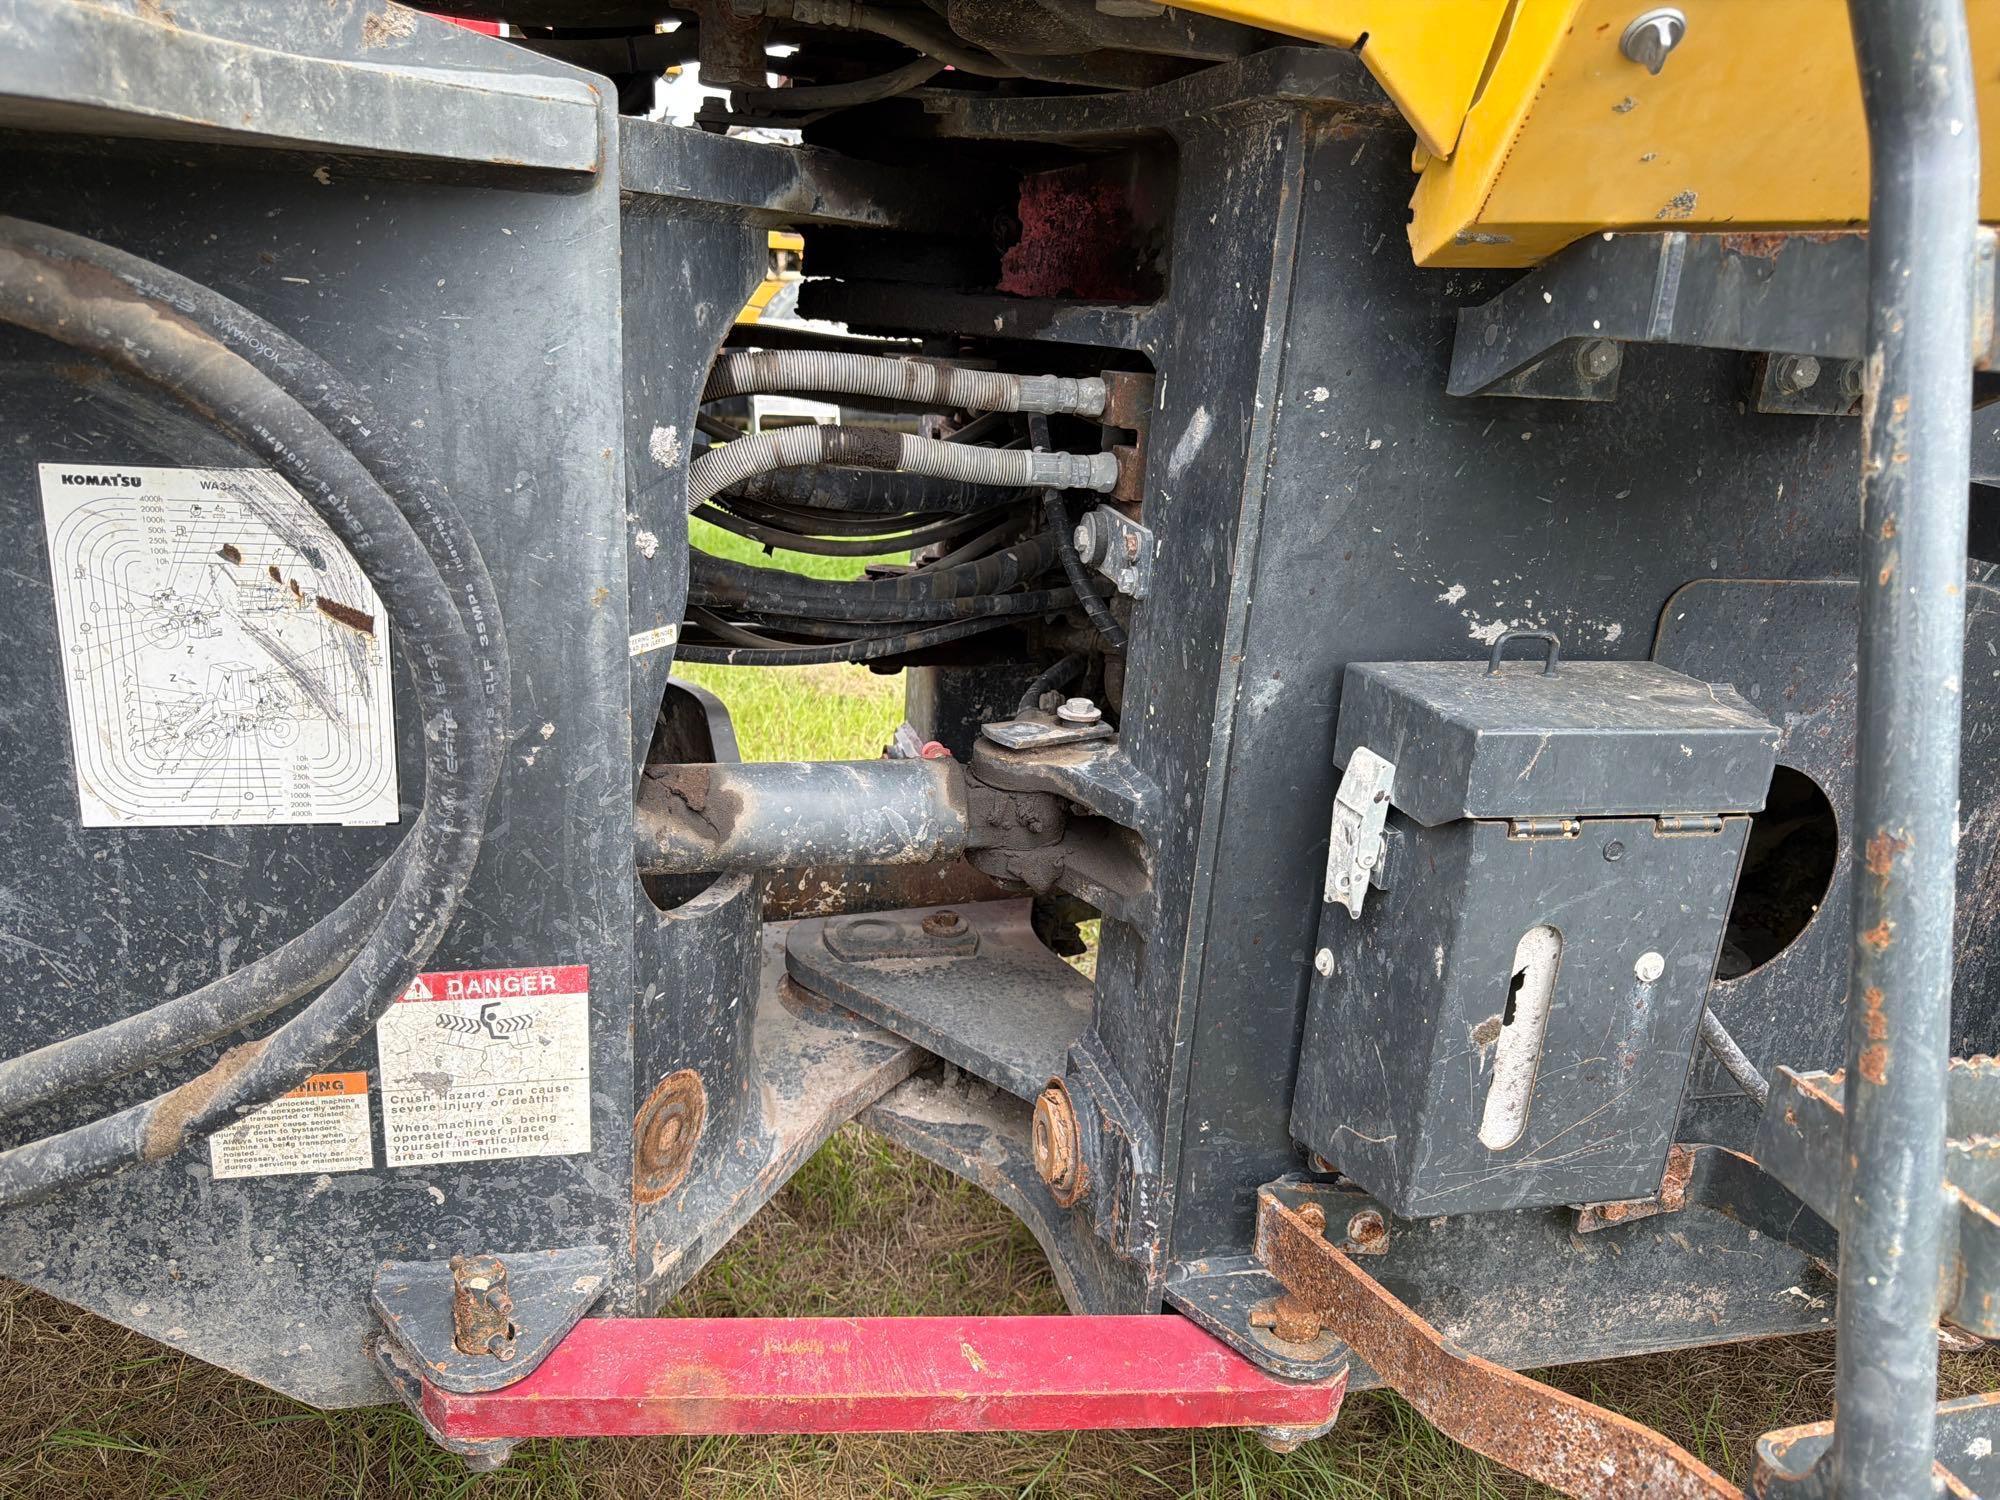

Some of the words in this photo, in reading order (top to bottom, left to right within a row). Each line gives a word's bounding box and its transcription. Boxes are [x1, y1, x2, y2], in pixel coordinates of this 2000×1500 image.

[213, 313, 279, 361] YOKOHAMA
[61, 473, 142, 488] KOMATSU
[141, 505, 164, 513] 2000h
[148, 526, 167, 534] 500h
[465, 583, 490, 648] 35MPa
[276, 629, 283, 637] Y
[187, 645, 194, 654] Z
[169, 674, 177, 682] Z
[224, 675, 231, 683] Y
[440, 787, 457, 845] YOOHAMA
[447, 975, 557, 996] DANGER
[295, 1081, 344, 1093] NING
[390, 1095, 431, 1105] Crush
[439, 1090, 490, 1101] Hazard.
[498, 1087, 523, 1097] Can
[531, 1085, 570, 1094] cause
[271, 1106, 326, 1116] unexpectedly
[391, 1104, 436, 1114] severe
[443, 1100, 482, 1111] injury
[250, 1114, 298, 1123] transported
[392, 1123, 429, 1133] When
[437, 1119, 493, 1130] machine
[502, 1117, 512, 1125] is
[520, 1114, 557, 1125] being
[213, 1131, 236, 1140] injury
[393, 1131, 457, 1143] operated,
[466, 1128, 502, 1137] never
[511, 1125, 545, 1136] place
[223, 1138, 253, 1146] Always
[276, 1135, 301, 1143] safety
[272, 1141, 296, 1149] being
[299, 1139, 347, 1148] transported
[394, 1141, 450, 1154] yourself
[457, 1140, 468, 1148] in
[477, 1134, 549, 1146] articulated
[302, 1152, 327, 1160] safety
[394, 1153, 423, 1161] area
[432, 1151, 444, 1159] of
[452, 1146, 512, 1157] machine.
[224, 1163, 252, 1171] during
[259, 1160, 297, 1169] servicing
